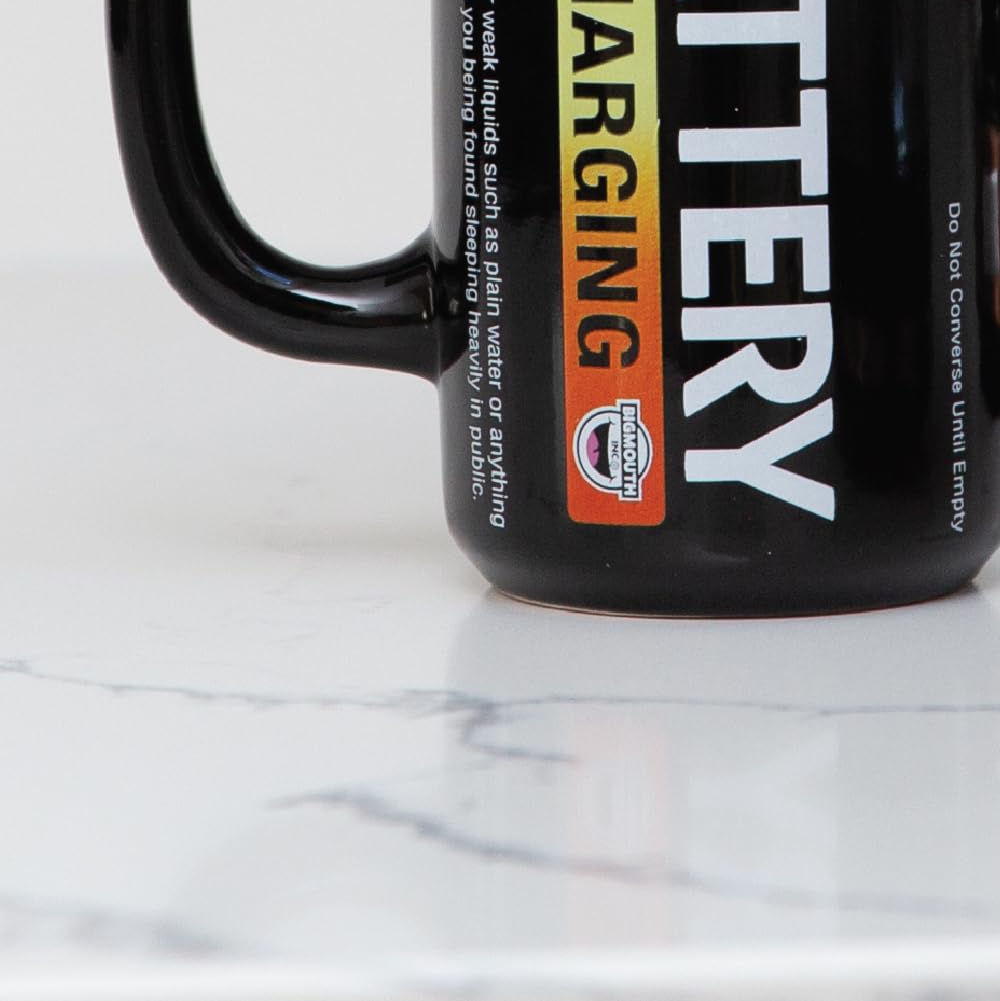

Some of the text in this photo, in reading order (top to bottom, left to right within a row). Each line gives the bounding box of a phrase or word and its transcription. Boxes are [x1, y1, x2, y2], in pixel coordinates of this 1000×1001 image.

[458, 7, 475, 50] you
[481, 10, 499, 71] weak
[459, 58, 477, 122] being
[480, 79, 500, 155] liquids
[462, 129, 479, 197] found
[483, 163, 501, 219] such
[463, 205, 481, 302] sleeping
[484, 227, 499, 253] as
[482, 261, 503, 316] plain
[465, 311, 484, 391] heavily
[487, 325, 503, 390] water
[948, 202, 967, 532] Do Not Converse Until Empty
[469, 398, 484, 418] in
[488, 397, 503, 422] or
[468, 426, 486, 500] public.
[487, 428, 508, 528] anything
[621, 405, 638, 497] BIGMOUTH
